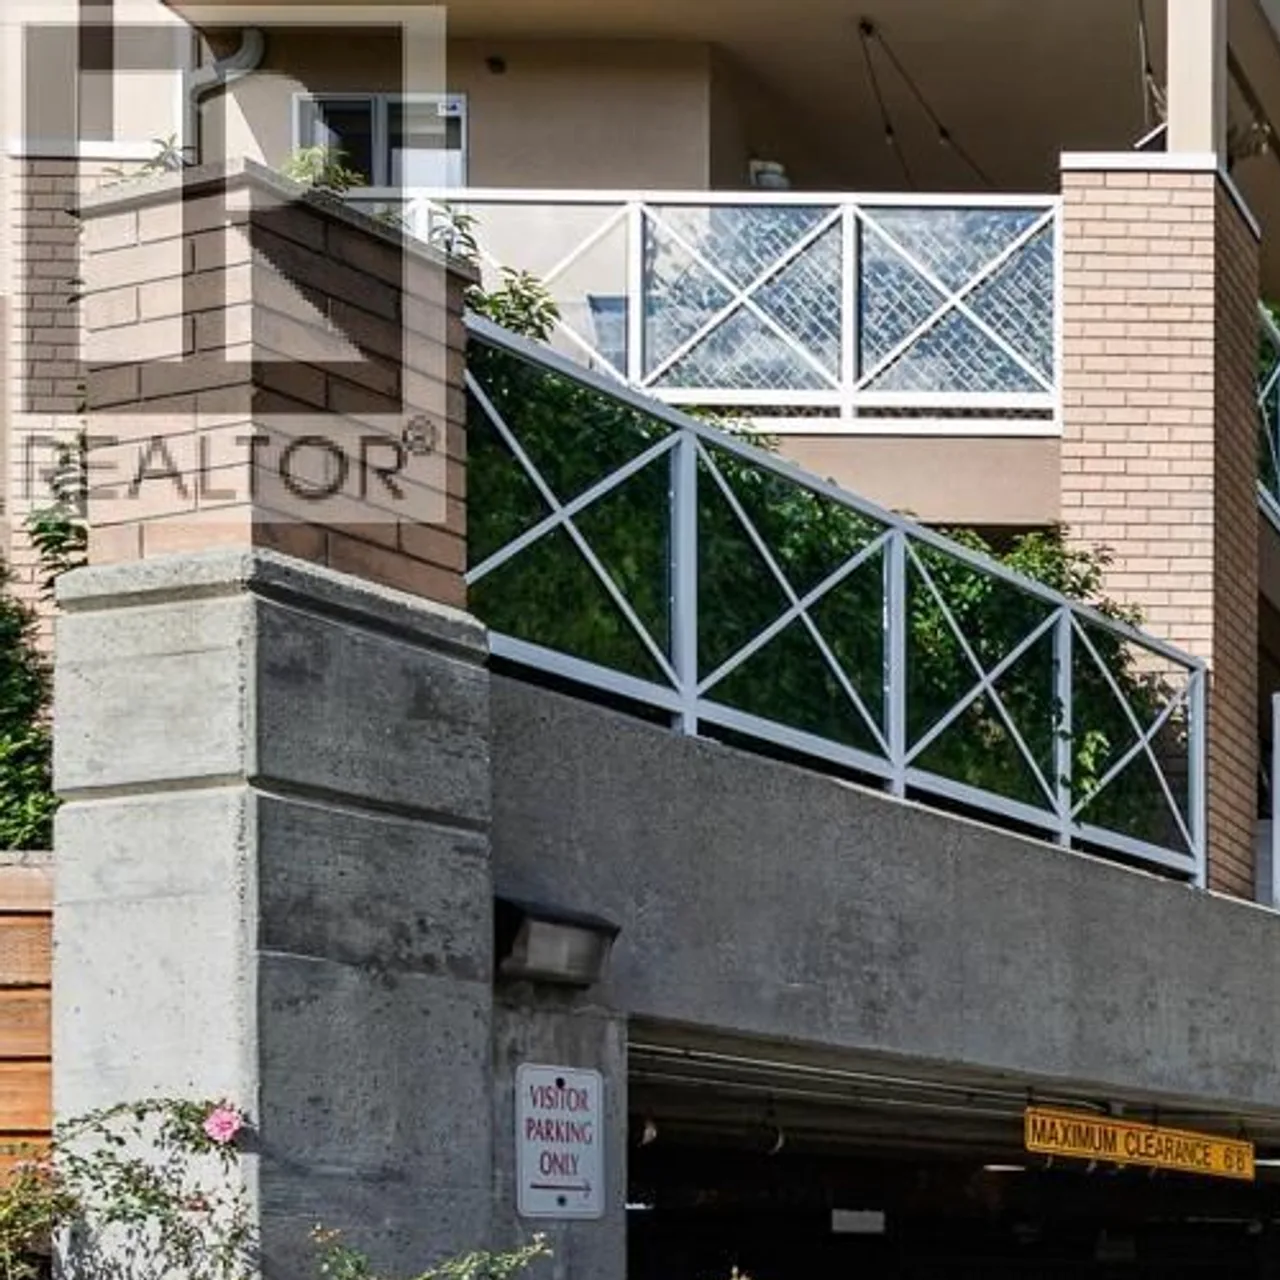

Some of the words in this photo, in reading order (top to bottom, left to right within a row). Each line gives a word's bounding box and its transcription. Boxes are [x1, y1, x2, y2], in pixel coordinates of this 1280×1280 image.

[530, 1084, 590, 1112] VISITOR
[526, 1116, 593, 1145] PARKING
[1032, 1117, 1117, 1153] MAXIMUM
[1124, 1130, 1212, 1167] CLEARANCE
[540, 1150, 579, 1176] ONLY
